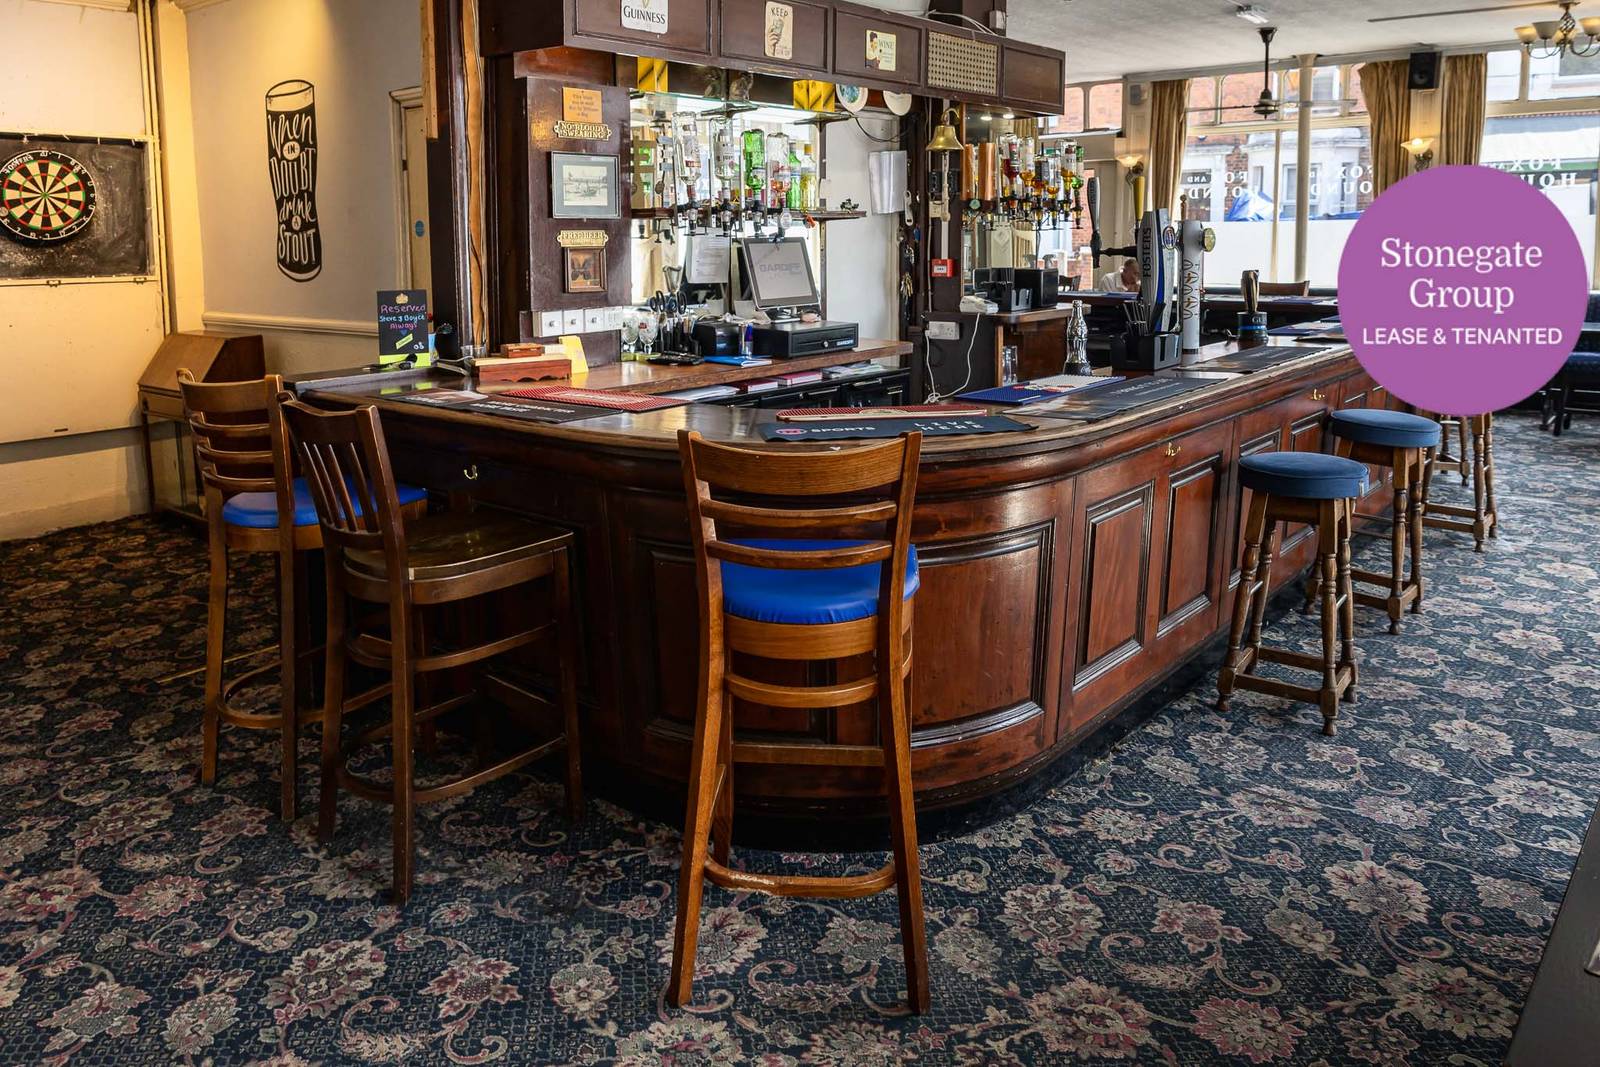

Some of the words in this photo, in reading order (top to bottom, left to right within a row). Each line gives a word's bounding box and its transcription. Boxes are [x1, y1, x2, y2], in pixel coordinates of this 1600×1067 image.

[623, 5, 666, 25] GUINNESS
[268, 113, 314, 158] When
[562, 130, 605, 138] SWEARING
[575, 124, 606, 132] BLOODY
[287, 143, 296, 155] IN
[270, 147, 317, 201] DOUBT
[279, 191, 317, 223] drink
[279, 223, 317, 265] STOUT
[380, 304, 426, 314] Reserved
